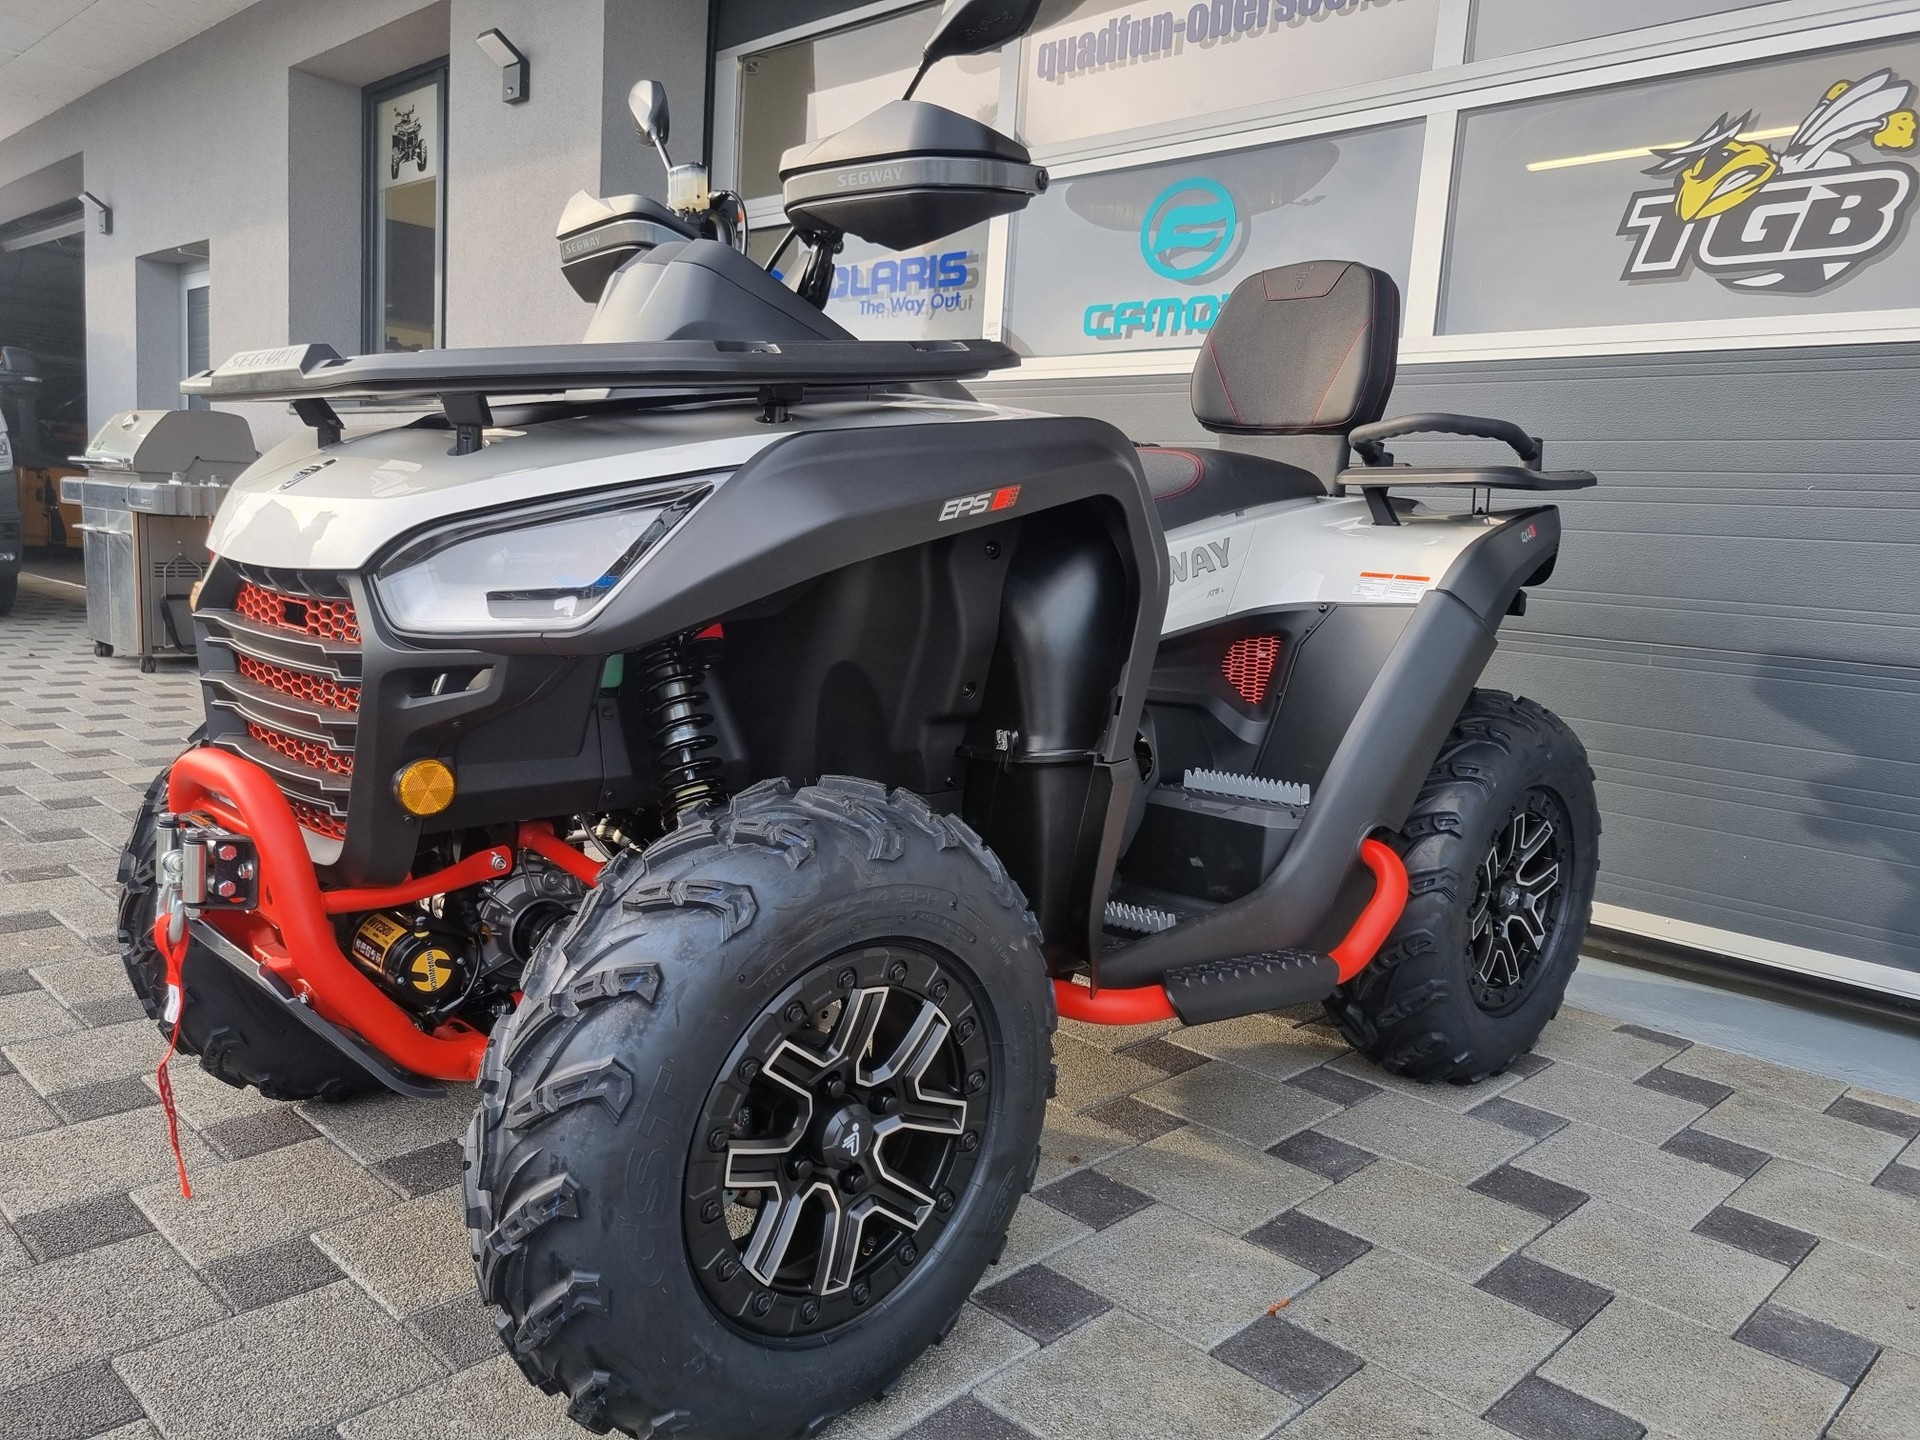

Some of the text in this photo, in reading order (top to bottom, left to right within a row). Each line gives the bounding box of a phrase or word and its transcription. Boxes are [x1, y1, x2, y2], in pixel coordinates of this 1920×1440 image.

[837, 167, 904, 188] SEGWAY
[1620, 165, 1914, 276] TGB
[565, 235, 601, 255] SEGWAY
[771, 251, 958, 300] OLARIS
[860, 291, 961, 316] The Way Out
[1083, 293, 1230, 336] CFMO
[227, 347, 301, 369] SEGWAY
[938, 492, 992, 522] EPS
